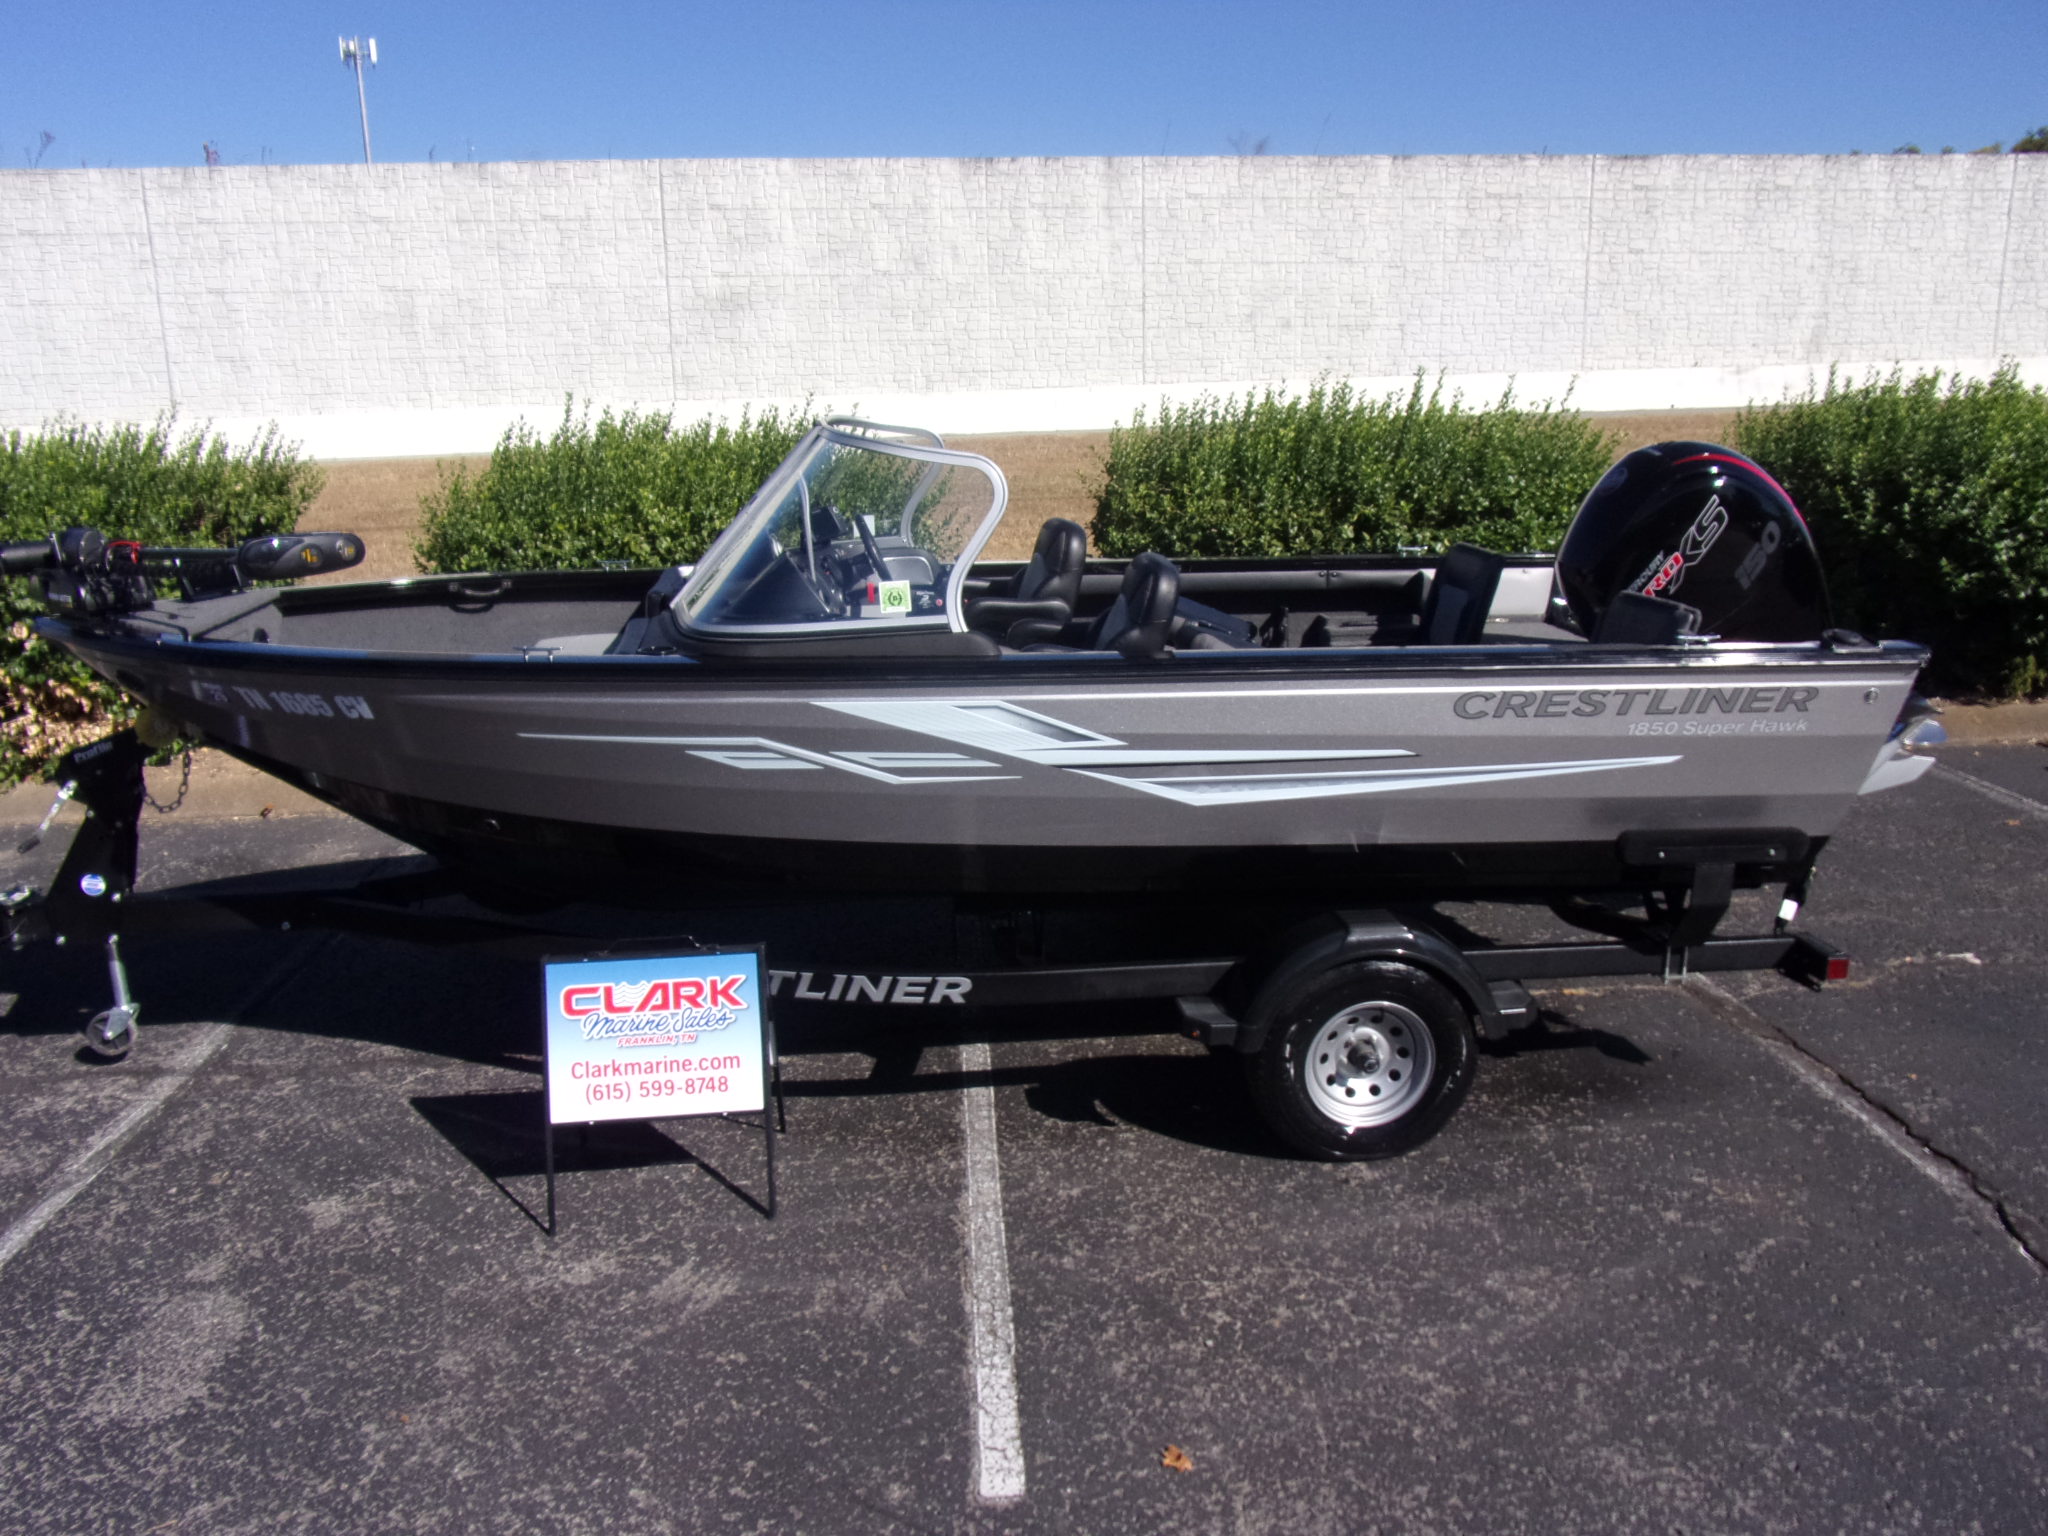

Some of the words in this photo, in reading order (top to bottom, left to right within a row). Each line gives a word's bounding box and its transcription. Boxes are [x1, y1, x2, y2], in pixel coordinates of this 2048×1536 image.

[1735, 520, 1781, 590] 150
[1453, 687, 1819, 720] CRESTLINER
[1627, 721, 1679, 736] 1850
[1682, 721, 1744, 736] Super
[1750, 719, 1808, 733] Hawk
[562, 976, 746, 1017] CLARK
[768, 969, 973, 1004] TLINER
[583, 1013, 670, 1037] Marine
[673, 1007, 734, 1032] Sales
[618, 1034, 678, 1046] FRANKLIN,
[681, 1034, 697, 1043] TN
[571, 1055, 741, 1079] Clarkmarine.com
[586, 1081, 631, 1105] (615)
[639, 1076, 729, 1098] 599-8748
